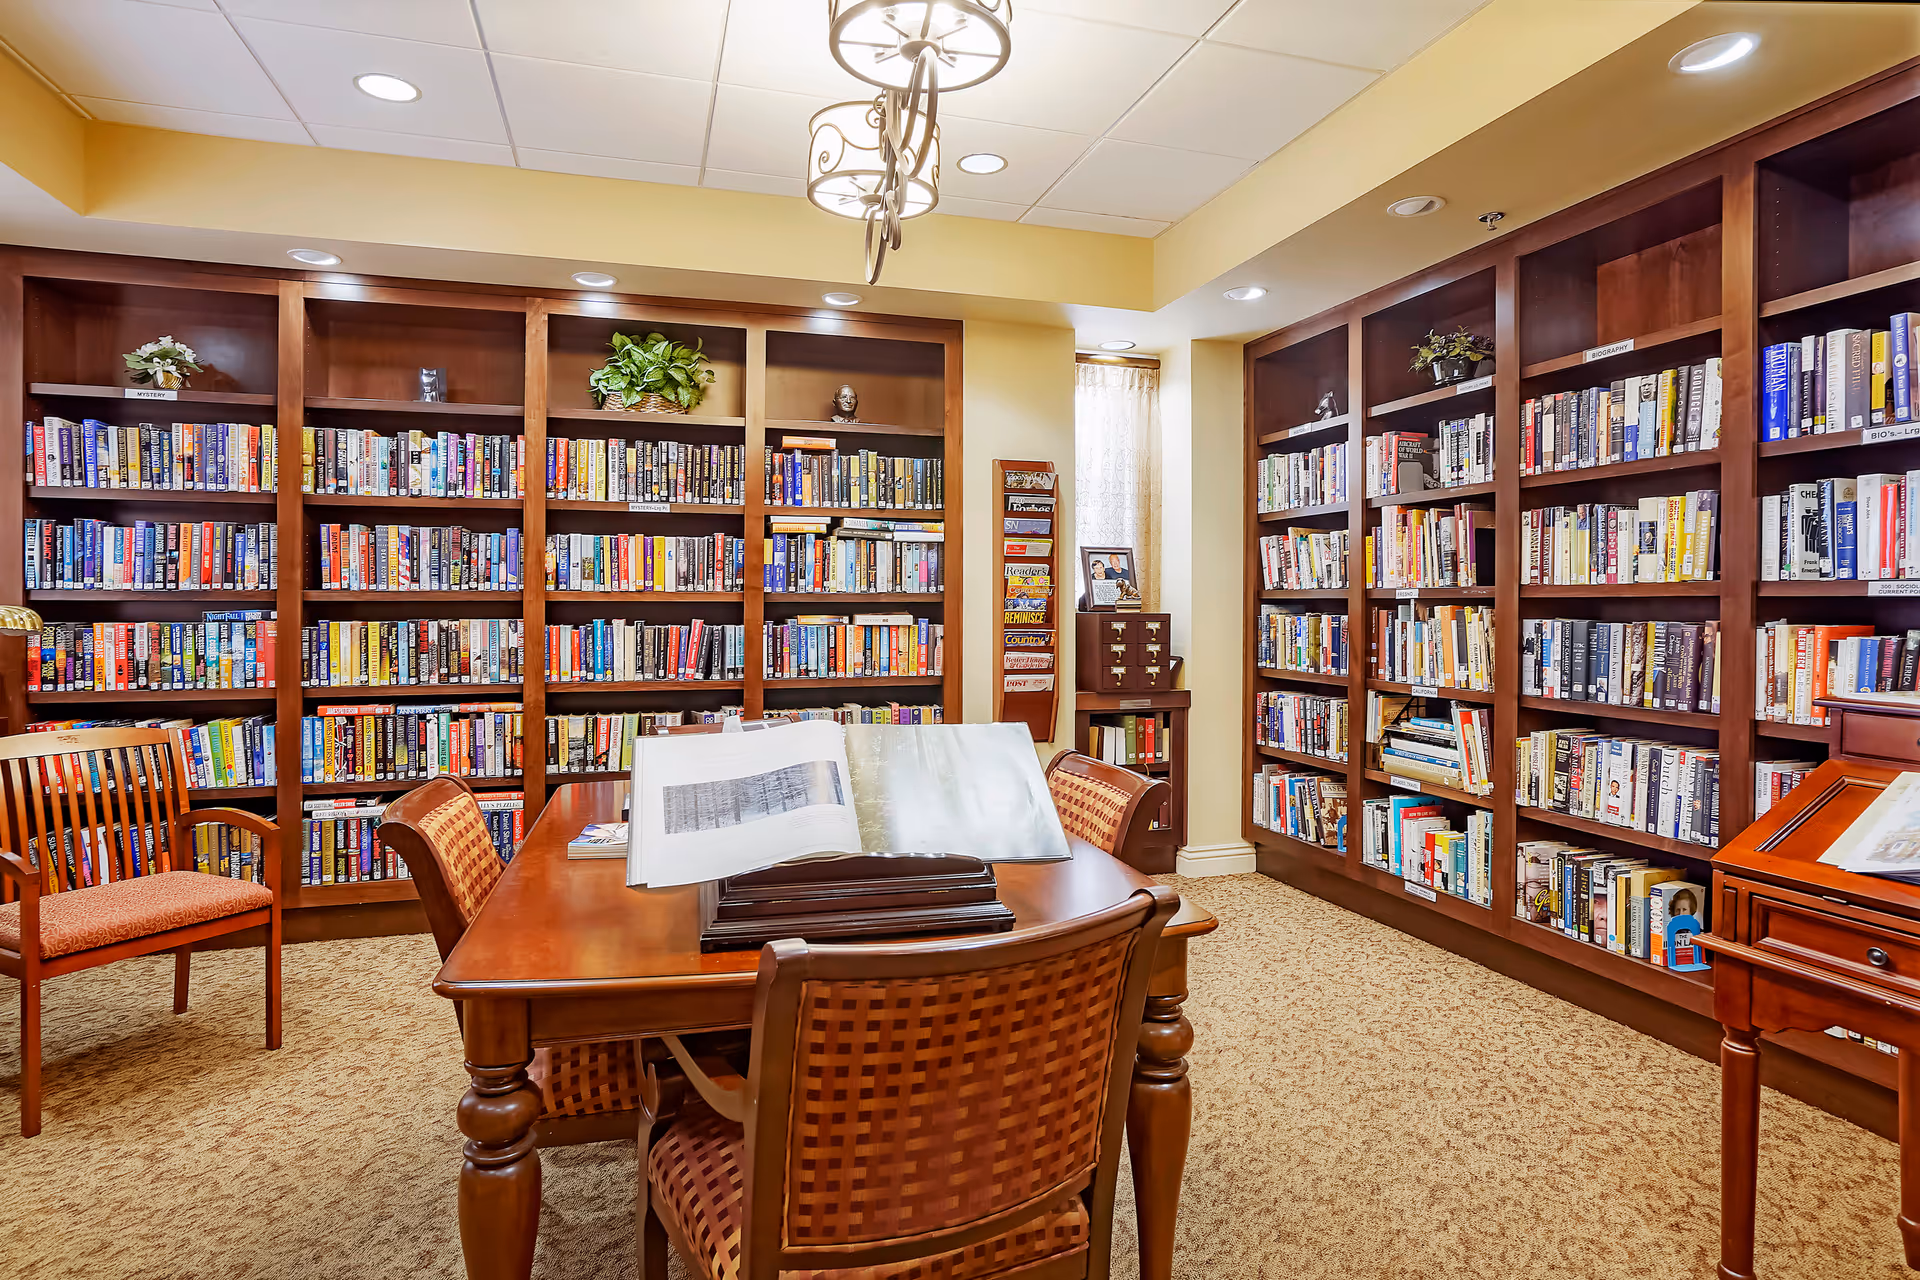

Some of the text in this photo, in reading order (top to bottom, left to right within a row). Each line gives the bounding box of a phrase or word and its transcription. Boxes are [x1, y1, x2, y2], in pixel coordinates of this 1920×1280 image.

[1592, 344, 1628, 359] BIOGRAPHY
[1851, 333, 1861, 368] SACRED
[1769, 347, 1786, 392] TRUMAN
[1690, 369, 1703, 413] COOLIDGE
[1676, 377, 1685, 443] CLEOPATRA
[84, 422, 94, 462] DAVID BALDACCI
[194, 426, 202, 468] DALE BROWN
[44, 524, 52, 536] TOM
[247, 528, 256, 548] STEPHEN
[1005, 520, 1019, 530] SN
[1820, 512, 1830, 546] GRANT
[44, 537, 52, 560] CLANCY
[1004, 611, 1044, 624] REMINISCE
[94, 640, 103, 658] CRAIS
[1005, 634, 1044, 645] Country
[1564, 638, 1570, 646] OF
[1611, 630, 1620, 681] Amanda Knox
[1798, 630, 1806, 650] GLENN
[1654, 640, 1666, 672] LINCOLN
[1797, 652, 1806, 669] BECK
[1903, 654, 1913, 686] AMERICA
[1570, 738, 1579, 787] STAN MUSIAL
[1640, 749, 1649, 785] PAVAROTTI
[1662, 754, 1675, 796] Dutch
[1680, 755, 1684, 764] MY
[1309, 780, 1320, 820] BASEBALL
[1686, 756, 1698, 826] COLIN POWELL
